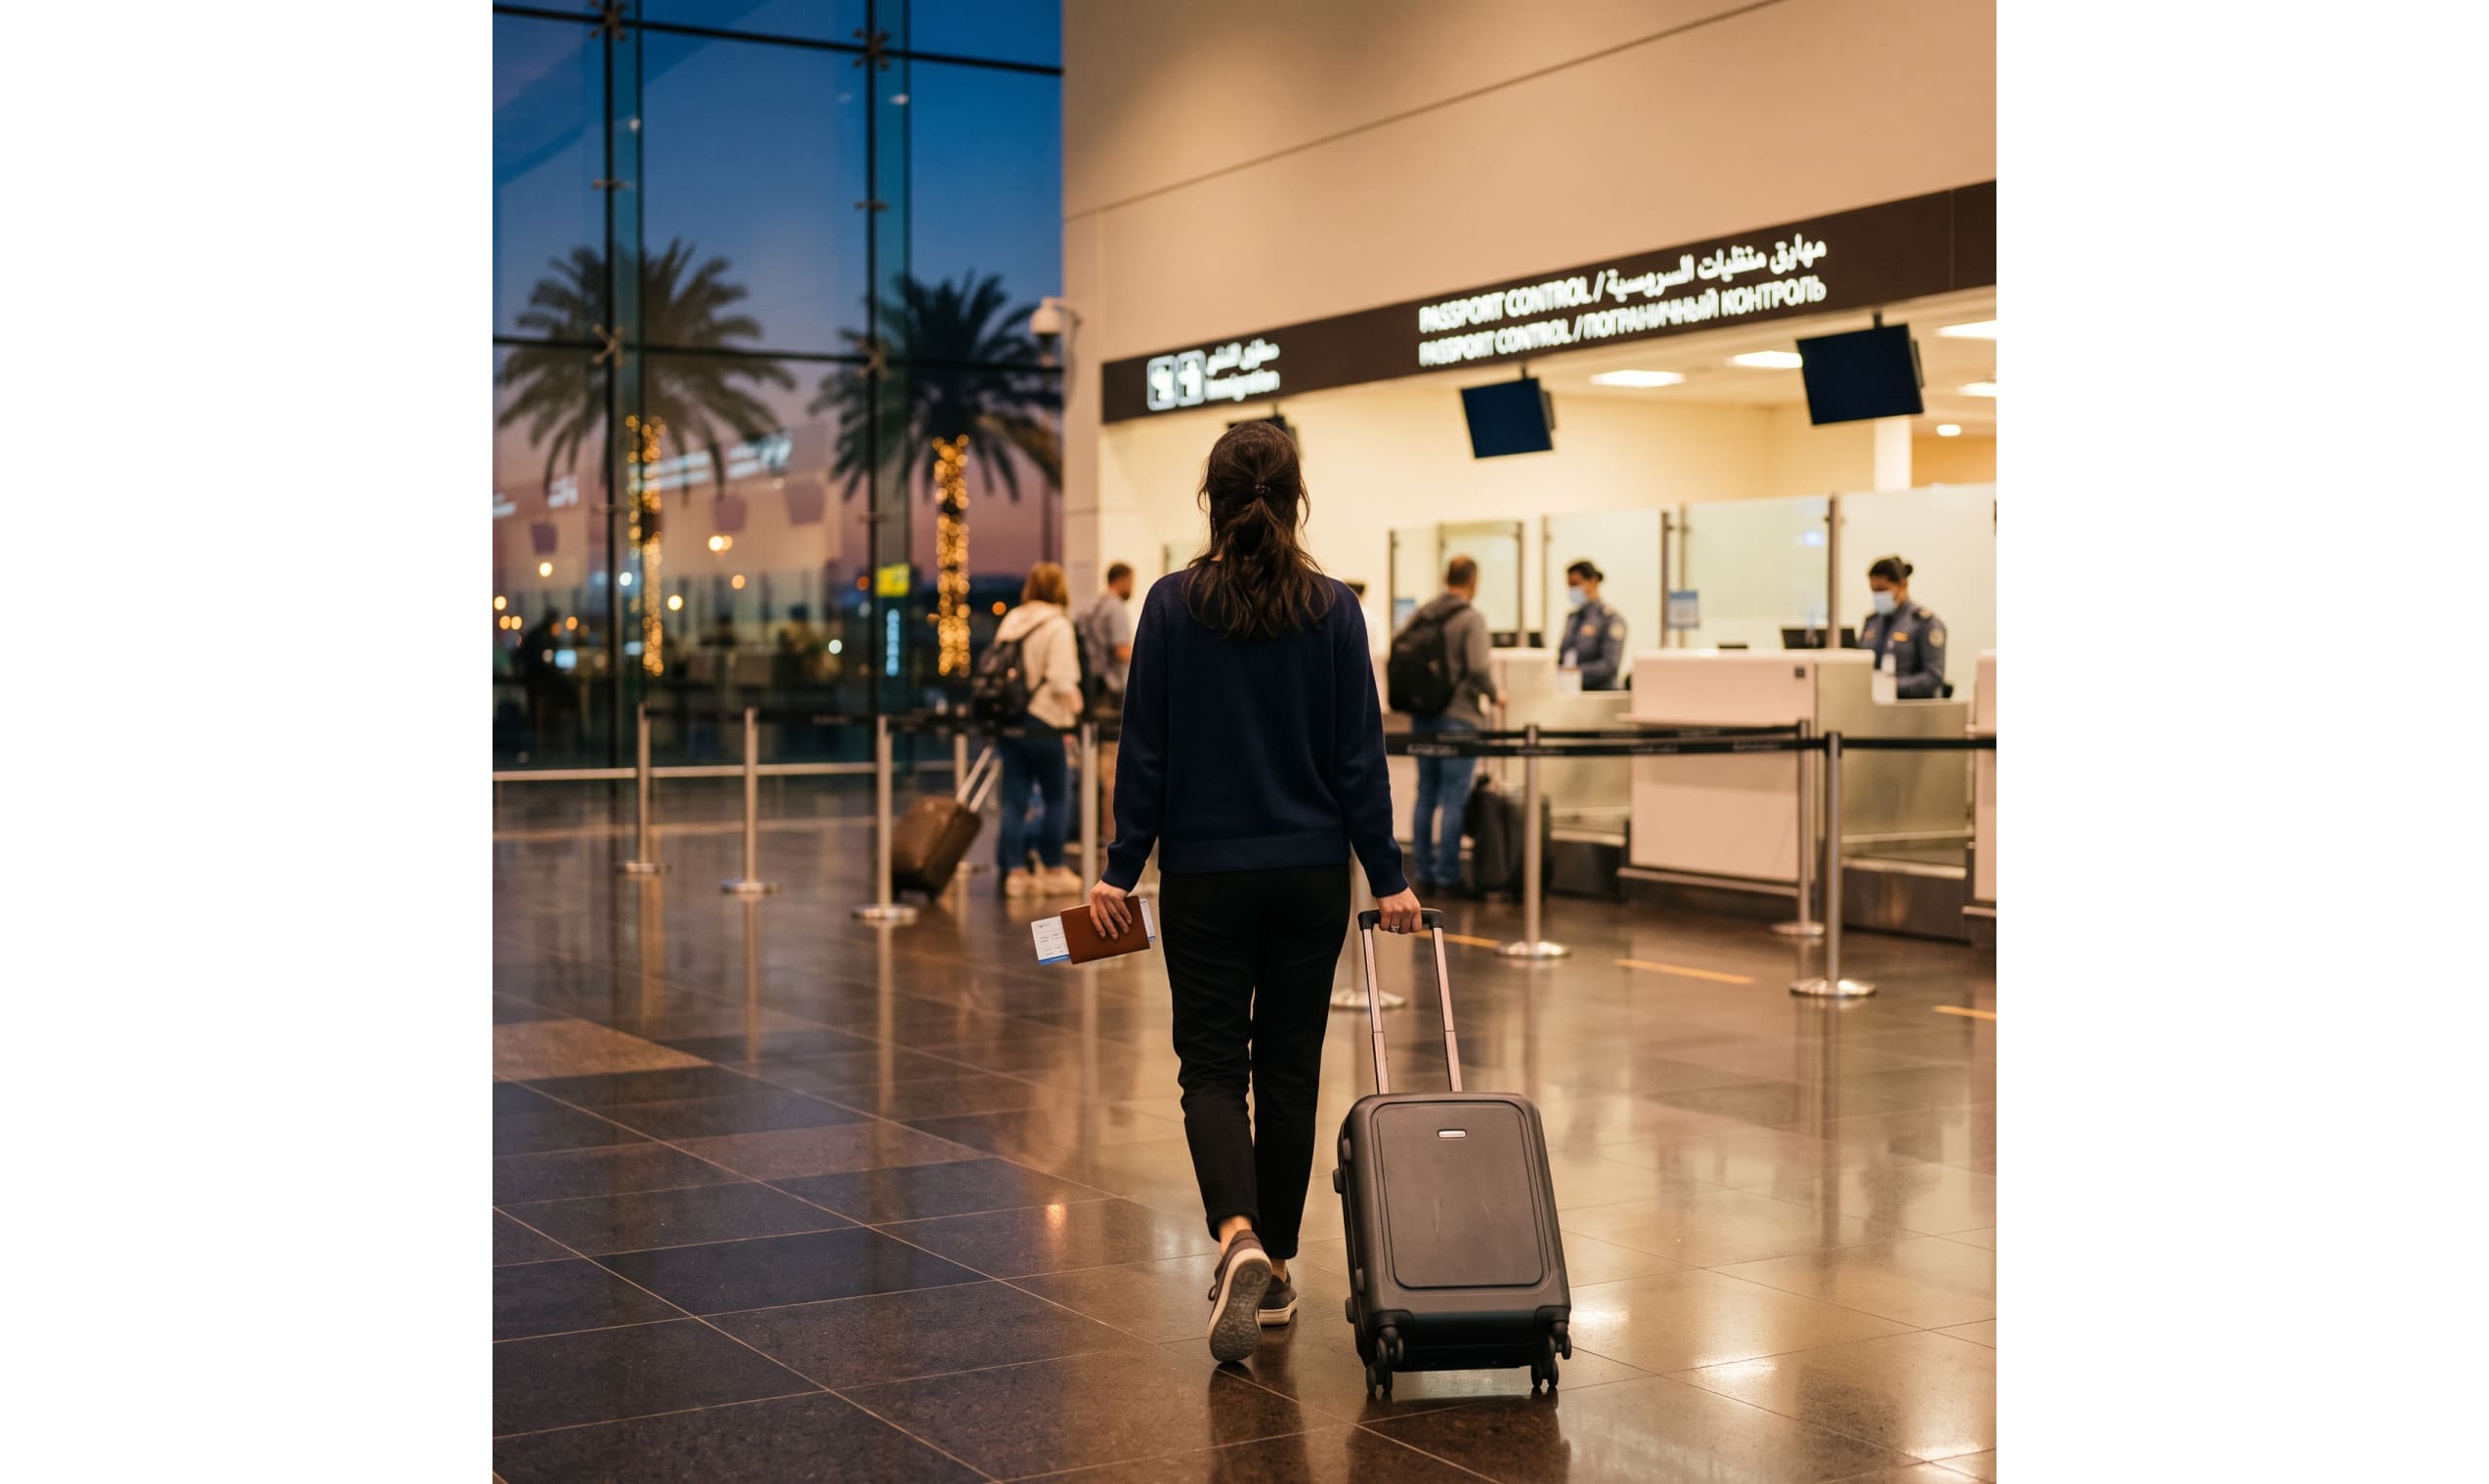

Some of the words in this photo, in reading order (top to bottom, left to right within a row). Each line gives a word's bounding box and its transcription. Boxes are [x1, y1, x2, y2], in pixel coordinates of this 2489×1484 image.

[1494, 318, 1572, 355] CONTROL
[1720, 275, 1827, 317] КОНТРОЛЬ
[1504, 276, 1592, 318] CONTROL
